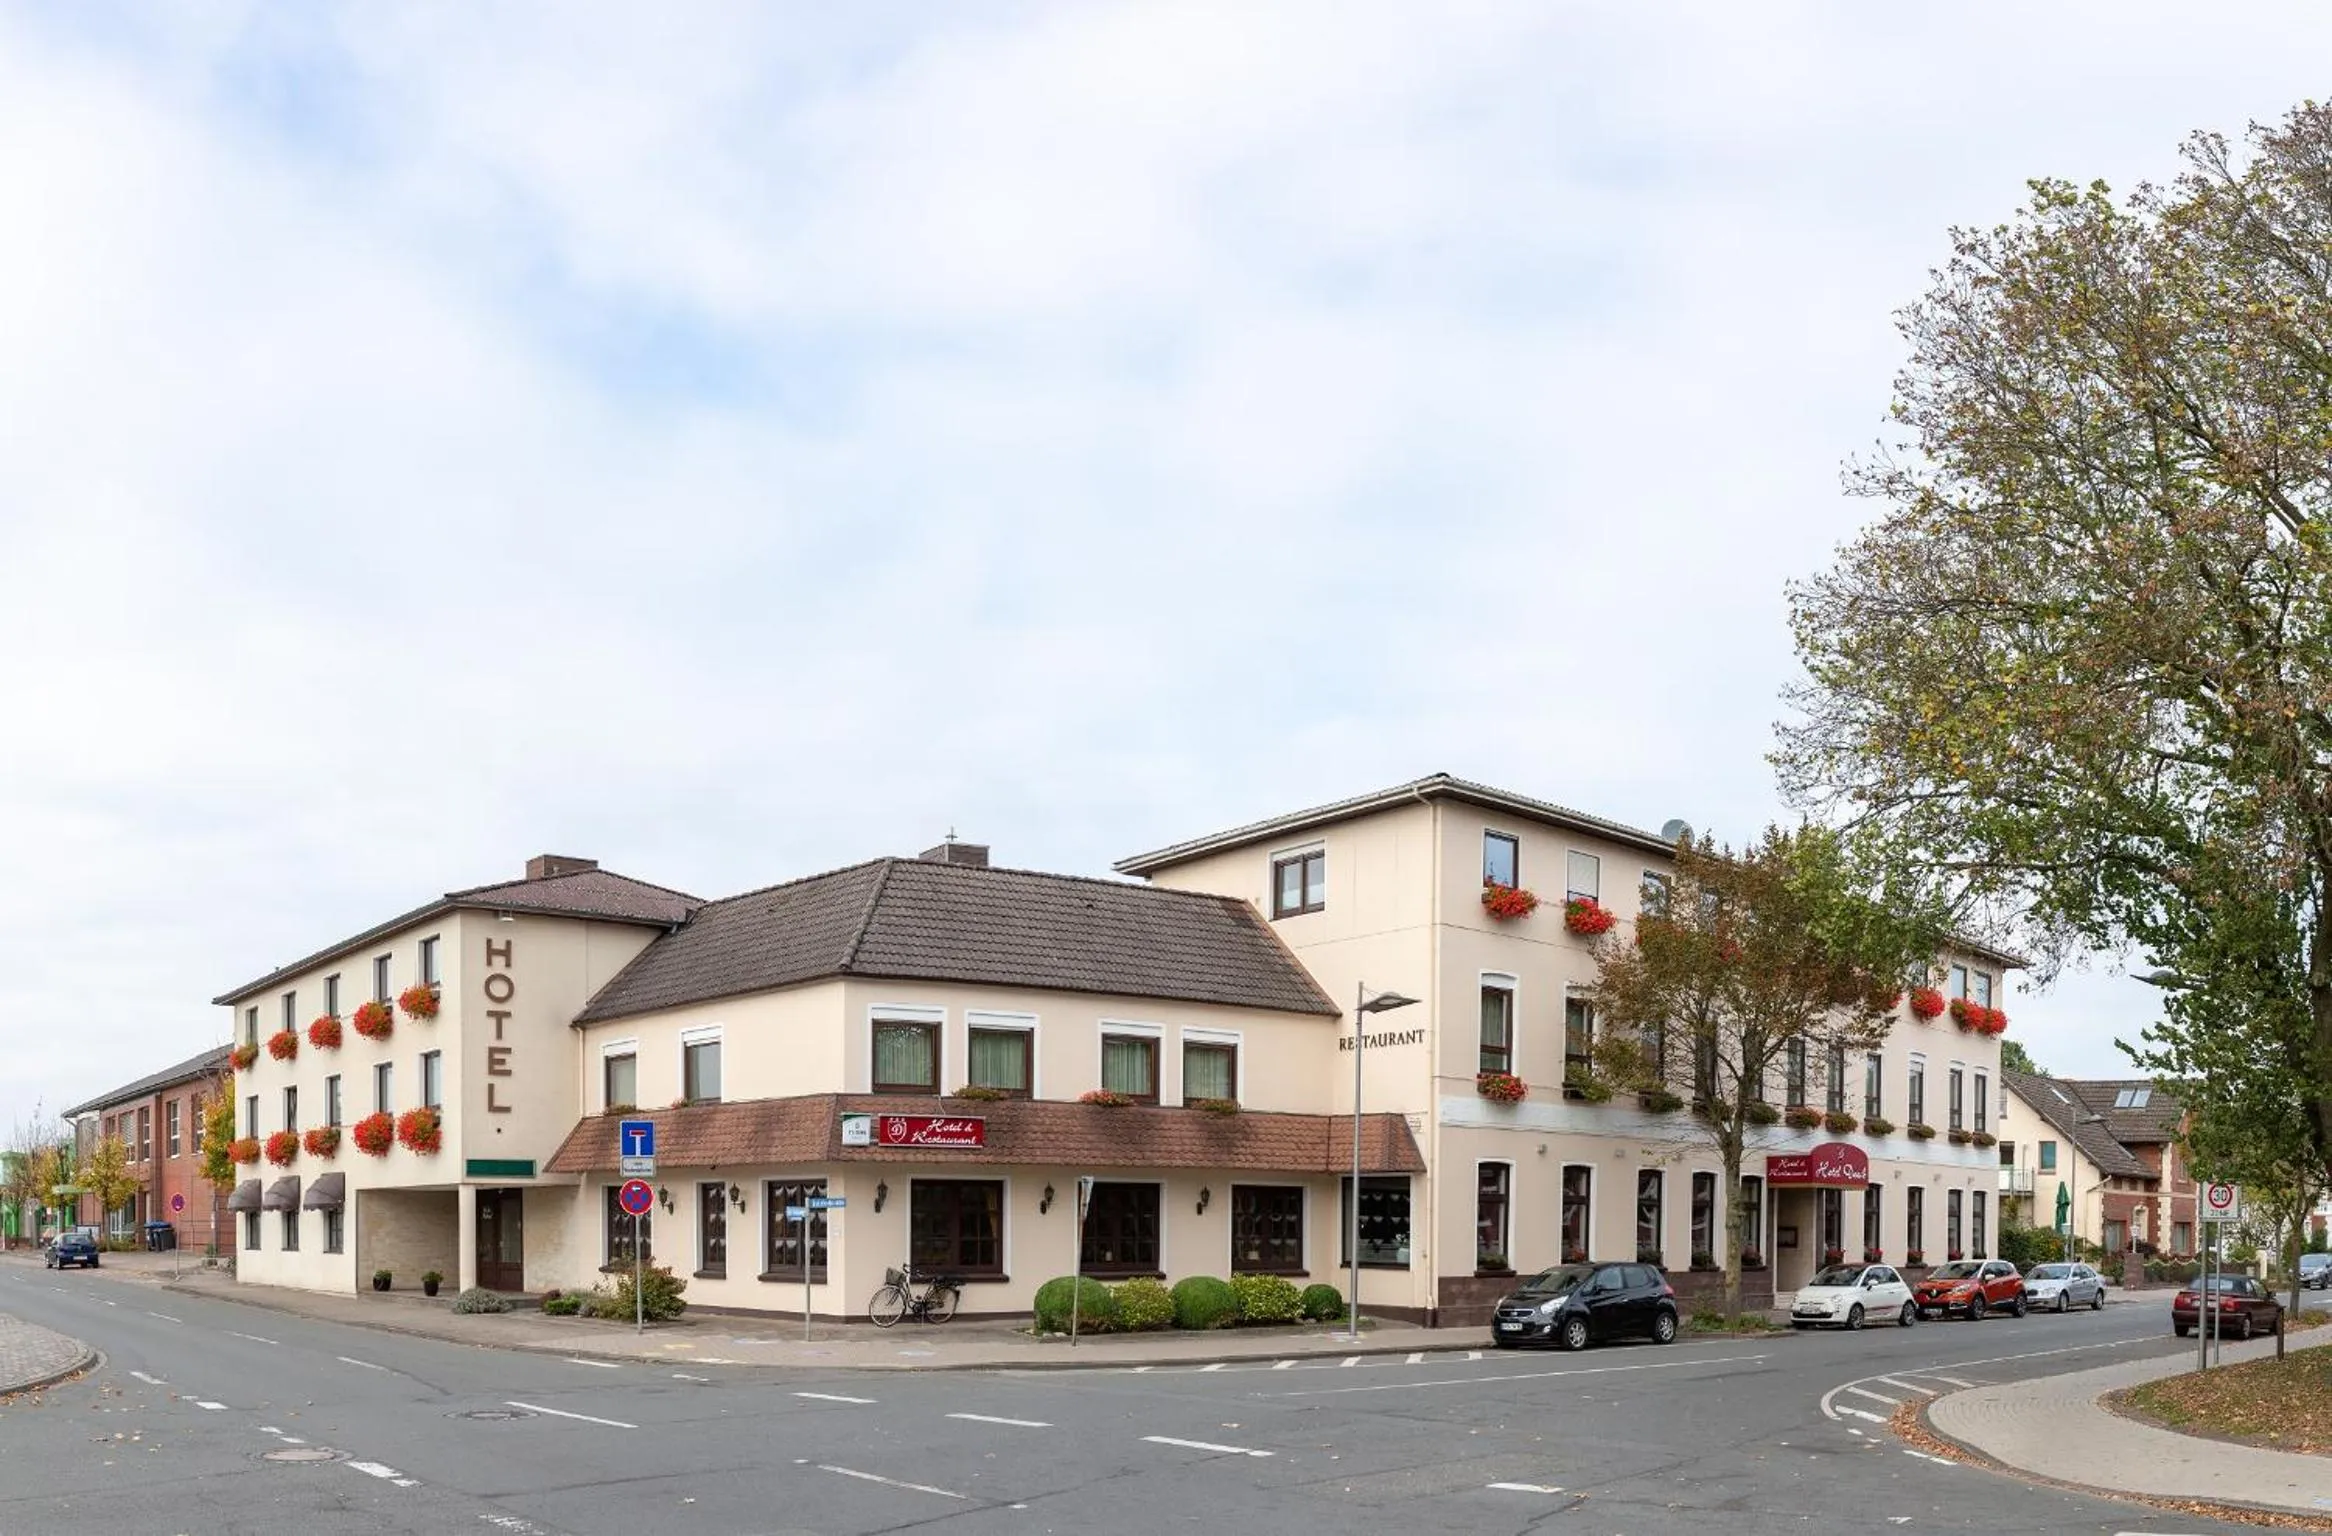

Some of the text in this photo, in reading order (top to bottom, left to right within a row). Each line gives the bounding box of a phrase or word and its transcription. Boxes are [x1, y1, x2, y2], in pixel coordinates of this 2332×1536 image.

[484, 937, 515, 1114] HOTEL
[926, 1119, 963, 1133] Hotel
[911, 1128, 976, 1145] Restaurant
[1815, 1161, 1842, 1178] Hotel
[2213, 1189, 2228, 1202] 30
